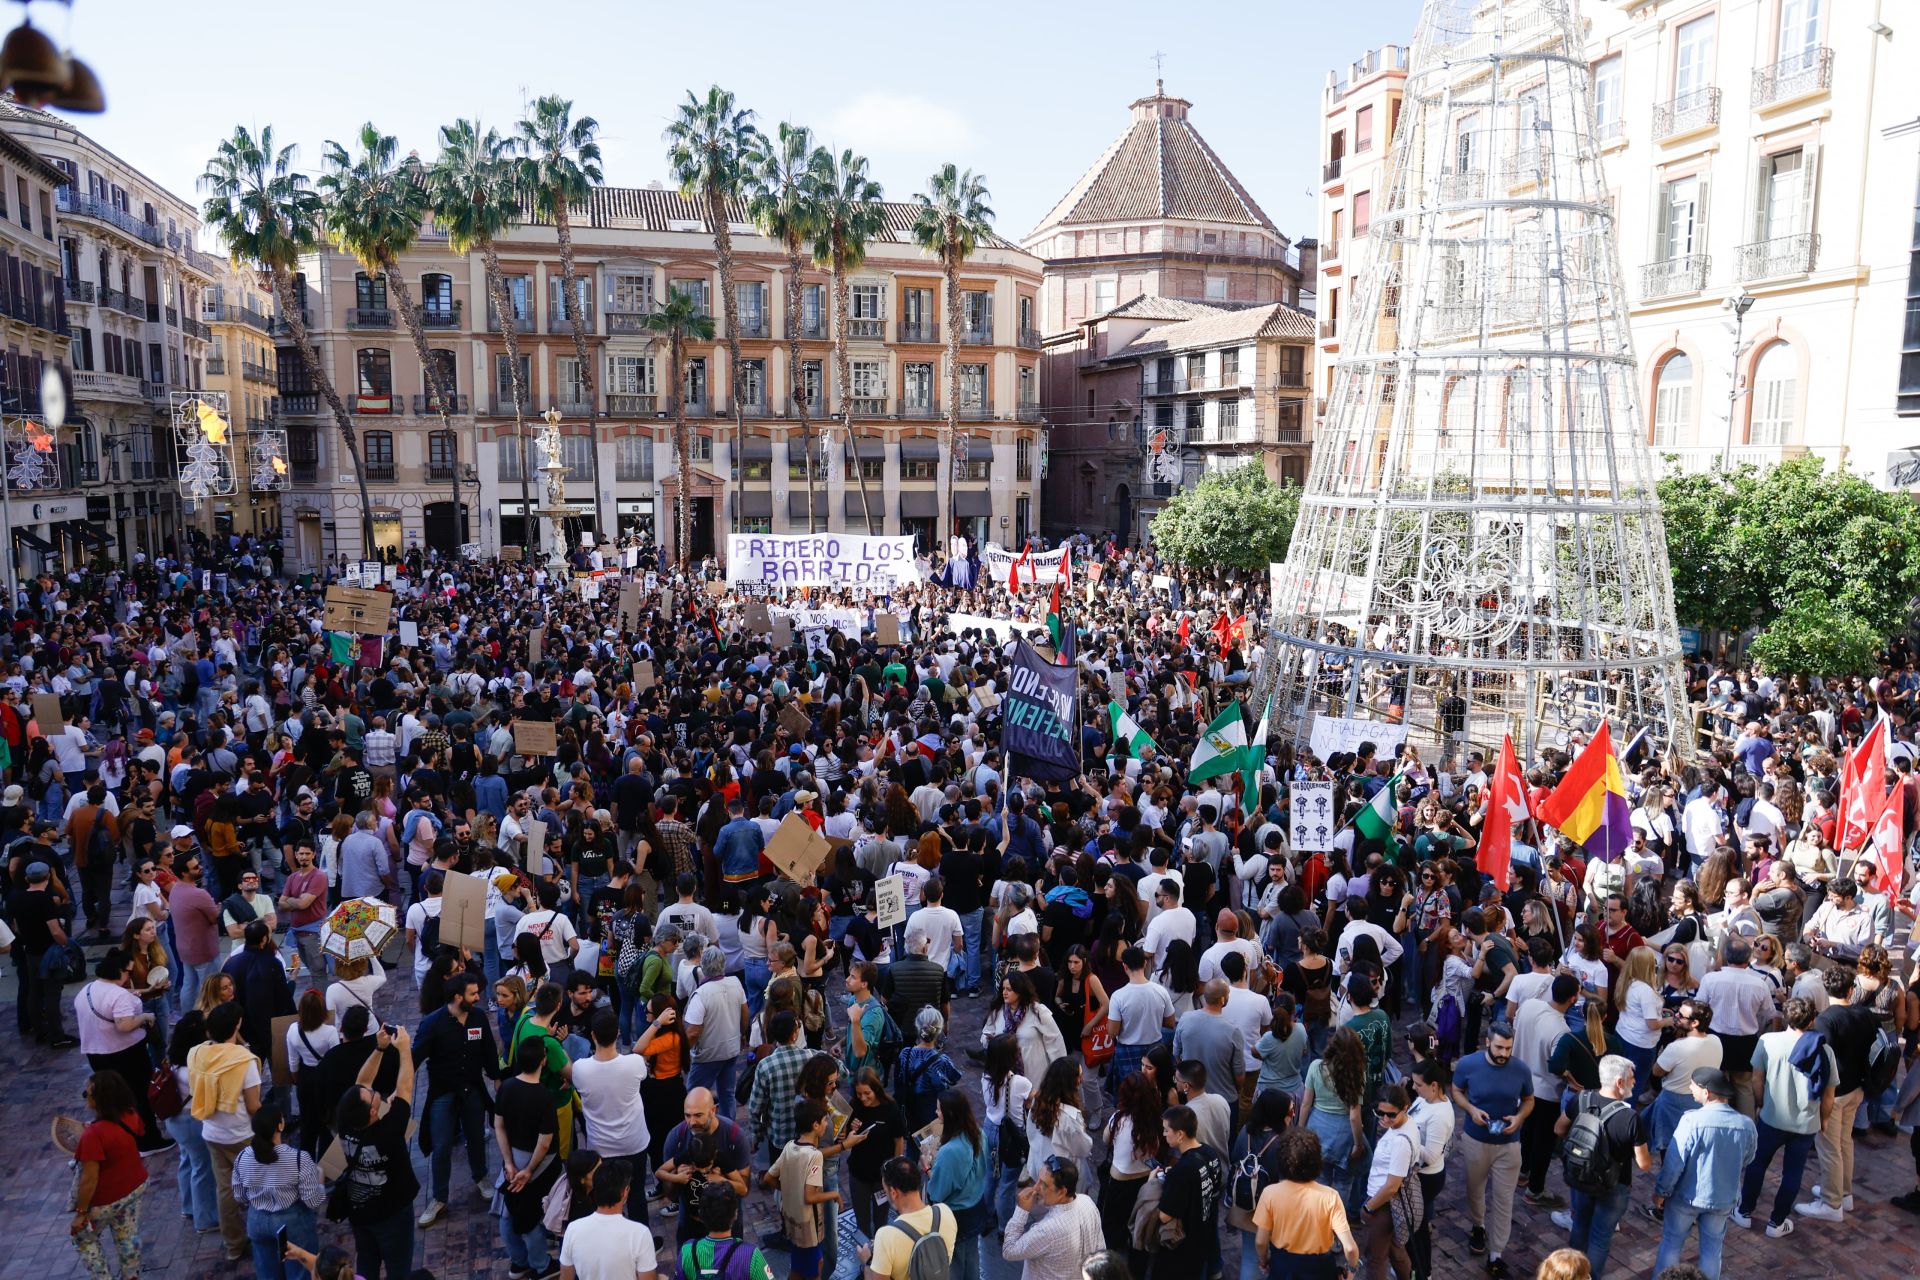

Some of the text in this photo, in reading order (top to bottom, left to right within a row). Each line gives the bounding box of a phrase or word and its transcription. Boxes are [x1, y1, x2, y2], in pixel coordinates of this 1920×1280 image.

[735, 538, 906, 561] PRIMERO LOS
[810, 613, 828, 625] NOS
[1319, 735, 1338, 752] NO
[1300, 781, 1331, 791] BOQUERONES
